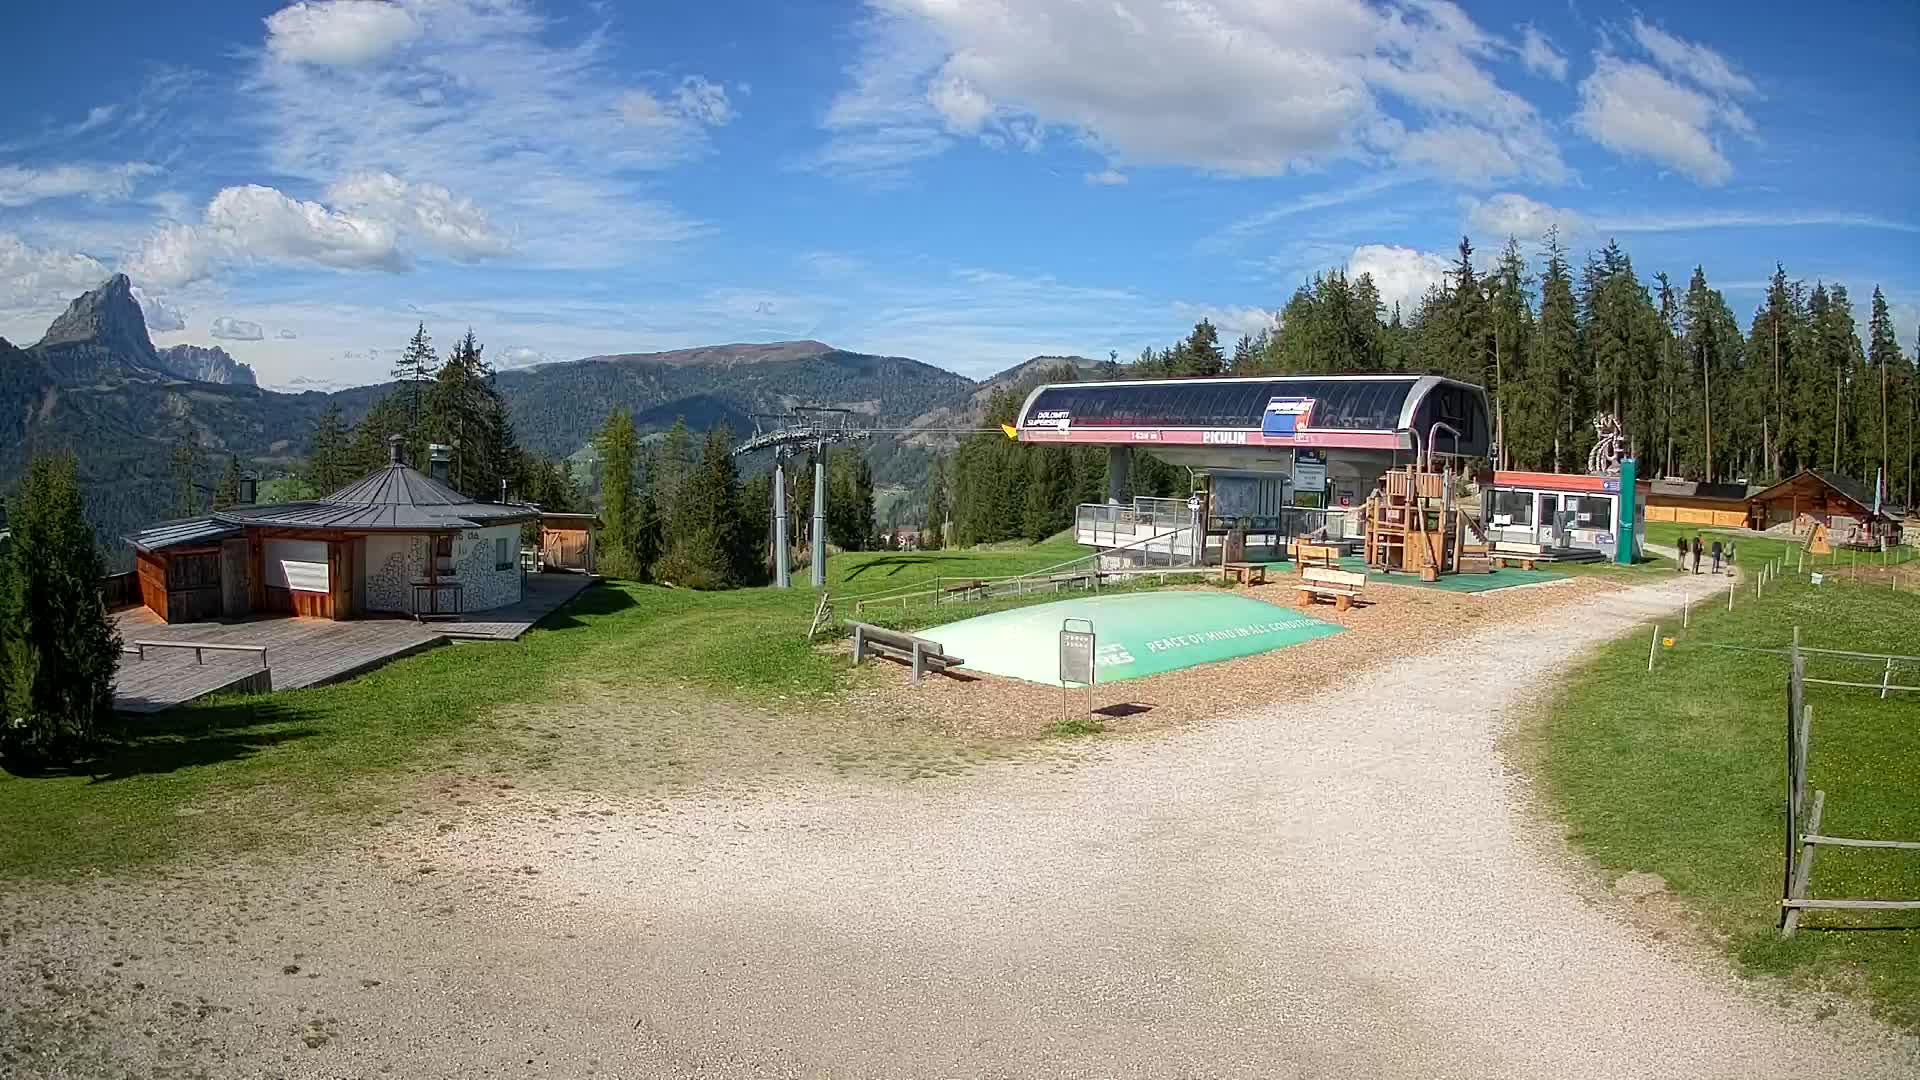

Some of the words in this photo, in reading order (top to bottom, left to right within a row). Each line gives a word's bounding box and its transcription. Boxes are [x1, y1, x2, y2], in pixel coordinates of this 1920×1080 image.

[1037, 411, 1070, 419] DOLOMITI
[1202, 431, 1247, 444] PICULIN
[1145, 635, 1190, 653] PEACE
[1188, 633, 1206, 645] OF
[1206, 629, 1236, 642] MIND
[1235, 627, 1251, 638] IN
[1249, 624, 1270, 636] ALL
